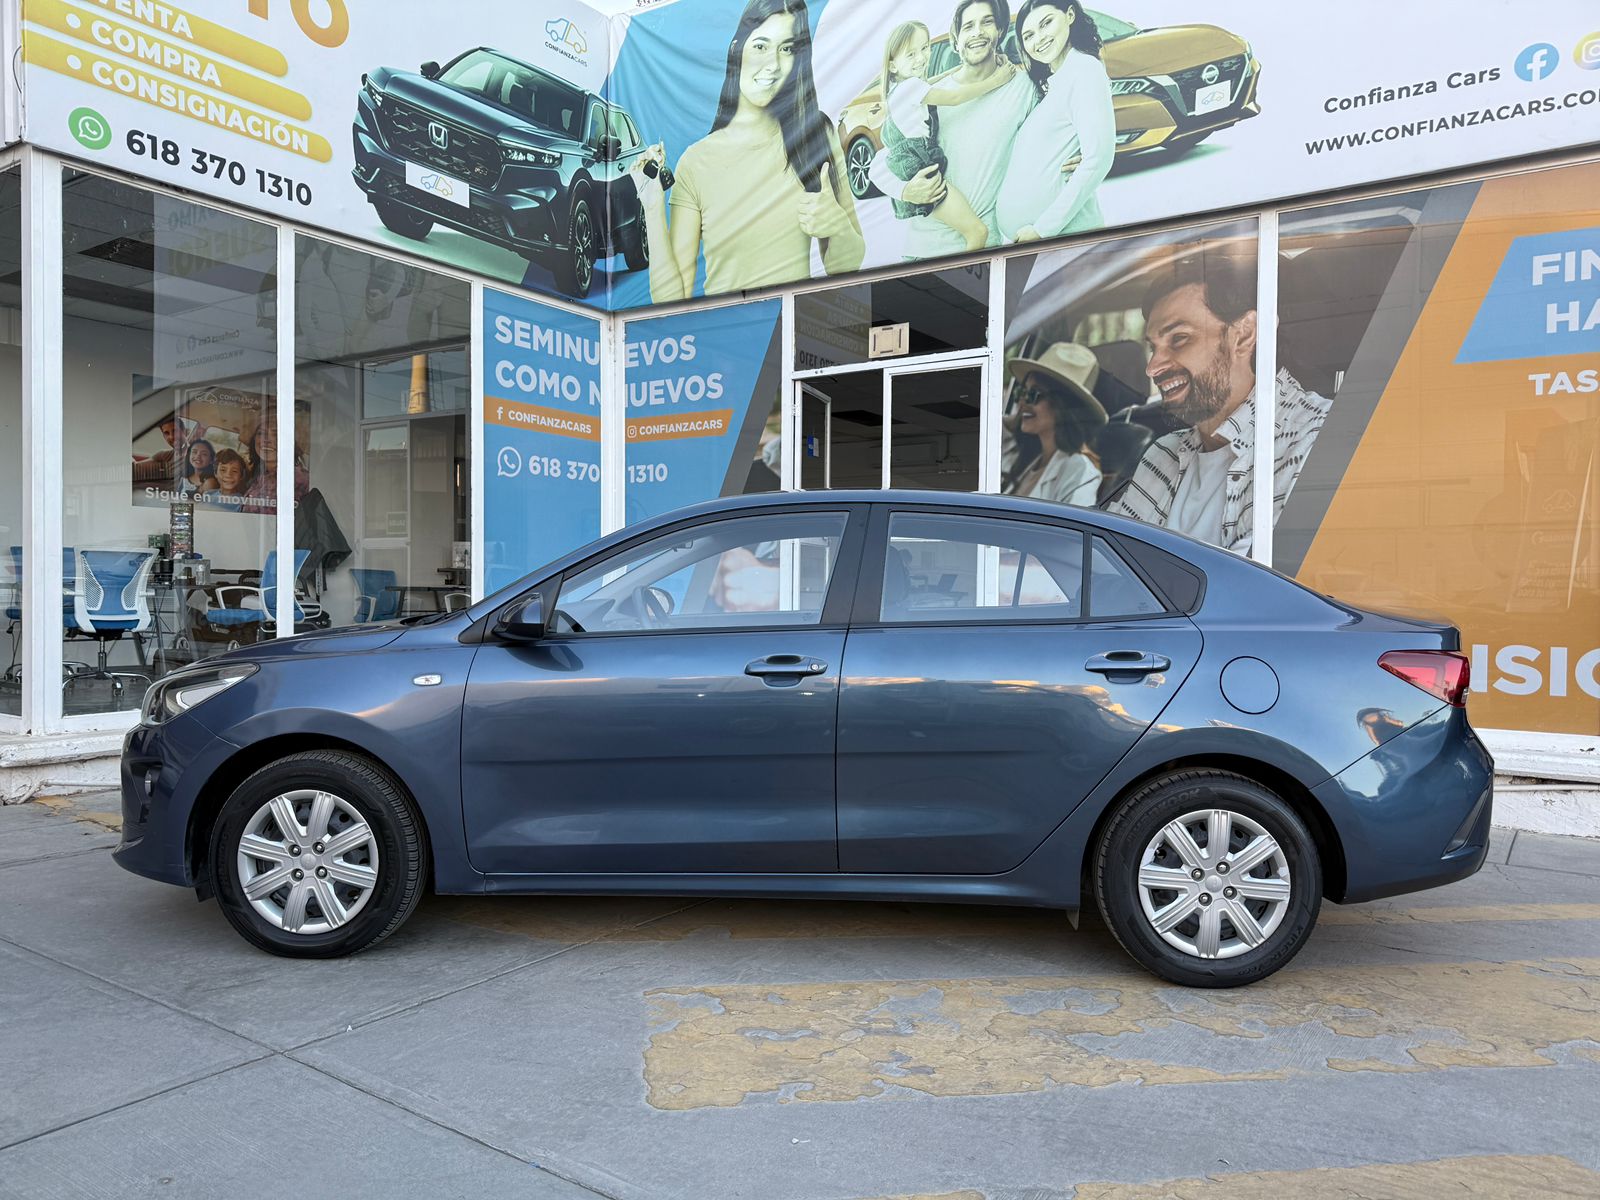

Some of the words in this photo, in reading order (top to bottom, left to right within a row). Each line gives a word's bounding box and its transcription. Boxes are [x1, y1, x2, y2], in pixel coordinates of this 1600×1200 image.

[100, 0, 194, 39] ENTA
[92, 20, 222, 87] COMPRA
[92, 61, 309, 154] CONSIGNACIÓN
[1324, 79, 1438, 114] Confianza
[1446, 66, 1501, 90] Cars
[1305, 88, 1600, 155] WWW.CONFIANZACARS.CO
[126, 129, 181, 167] 618
[191, 148, 246, 186] 370
[256, 168, 312, 206] 1310
[494, 360, 581, 402] COMO
[1528, 369, 1600, 397] TAS
[508, 410, 592, 434] CONFIANZACARS
[639, 419, 723, 436] CONFIANZACARS
[528, 455, 562, 476] 618
[566, 461, 600, 482] 370
[628, 463, 668, 484] 1310
[145, 487, 189, 503] Sigue
[193, 492, 211, 503] en
[218, 495, 299, 509] movimieo
